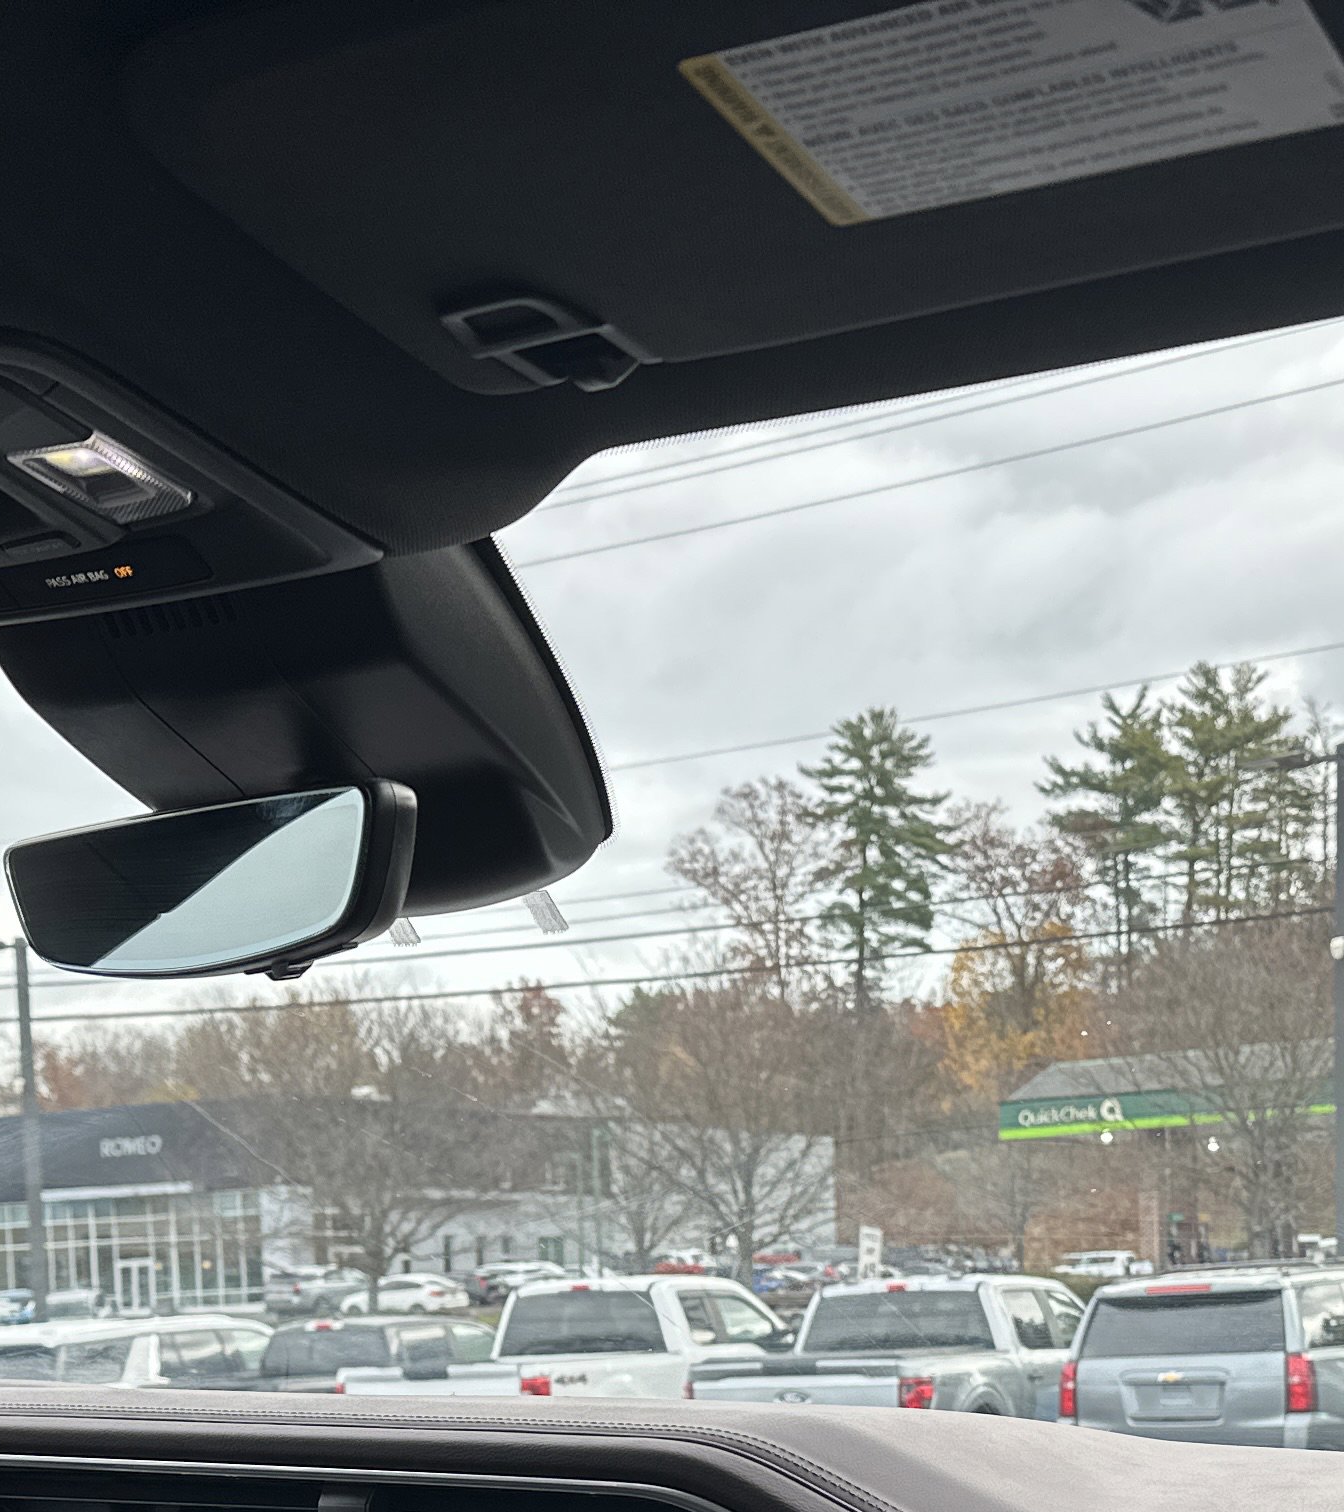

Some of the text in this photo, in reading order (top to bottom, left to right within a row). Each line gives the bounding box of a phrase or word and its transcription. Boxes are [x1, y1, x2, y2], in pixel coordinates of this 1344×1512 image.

[45, 565, 134, 588] PASS AIR BAG OFF
[99, 1135, 163, 1158] ROMEO
